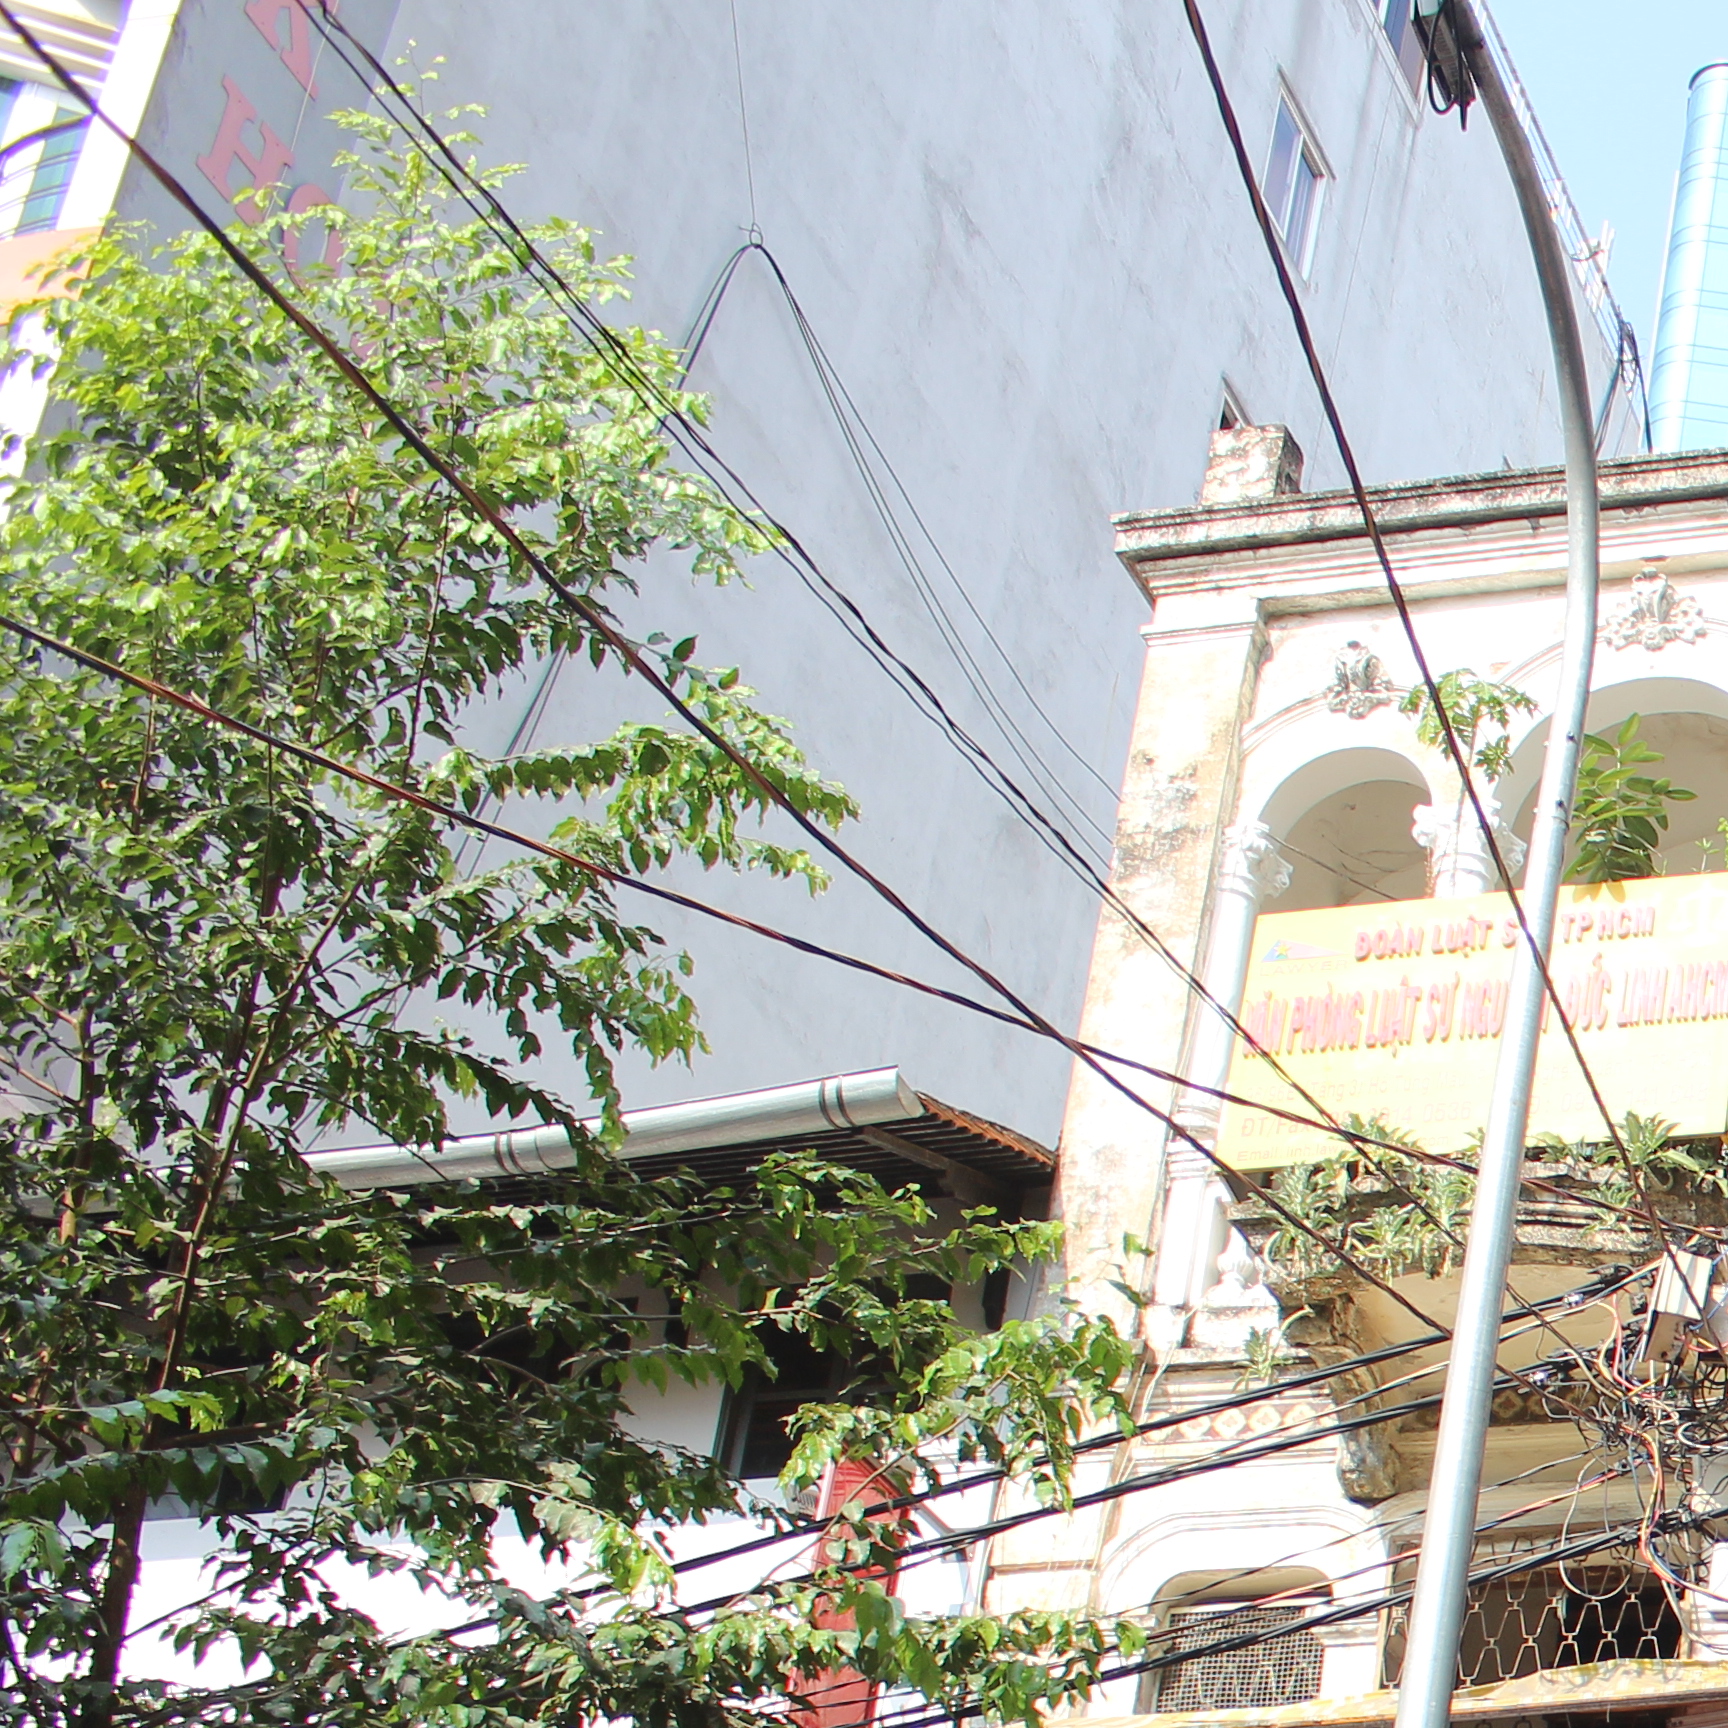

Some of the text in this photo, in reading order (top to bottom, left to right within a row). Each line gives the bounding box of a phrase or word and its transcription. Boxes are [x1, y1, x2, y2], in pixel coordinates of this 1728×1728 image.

[1355, 921, 1424, 961] ĐOÀN
[1432, 915, 1493, 958] LUẬT
[1243, 990, 1288, 1058] VĂN
[1286, 981, 1364, 1055] PHÒNG
[1365, 975, 1421, 1058] LUẬT
[1423, 972, 1460, 1043] SƯ
